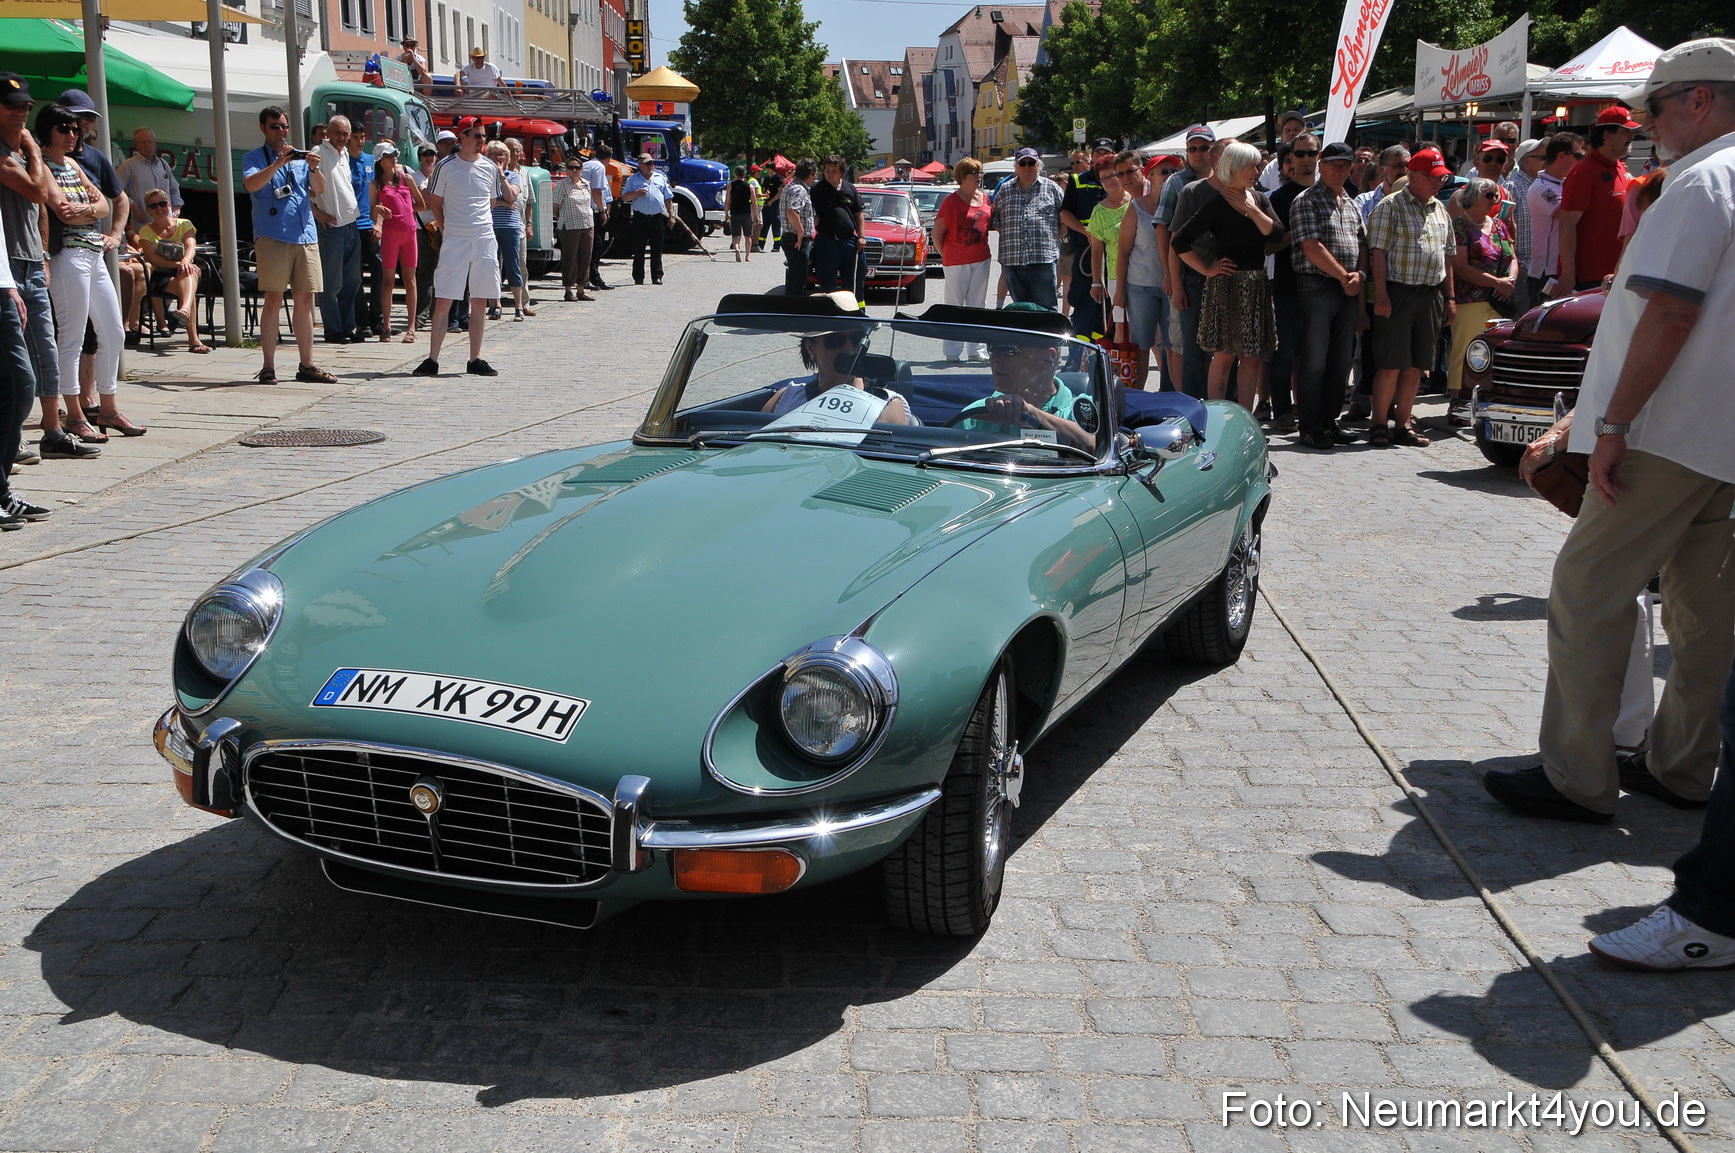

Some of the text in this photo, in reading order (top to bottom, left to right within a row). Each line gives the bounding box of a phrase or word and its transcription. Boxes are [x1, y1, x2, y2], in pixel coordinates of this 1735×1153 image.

[1441, 44, 1488, 101] Lehmeier's
[1599, 58, 1655, 76] Lehmei
[1469, 76, 1489, 94] IMBISS
[818, 396, 854, 414] 198
[1490, 422, 1503, 440] NM
[340, 673, 408, 704] NM
[416, 680, 485, 715] XK
